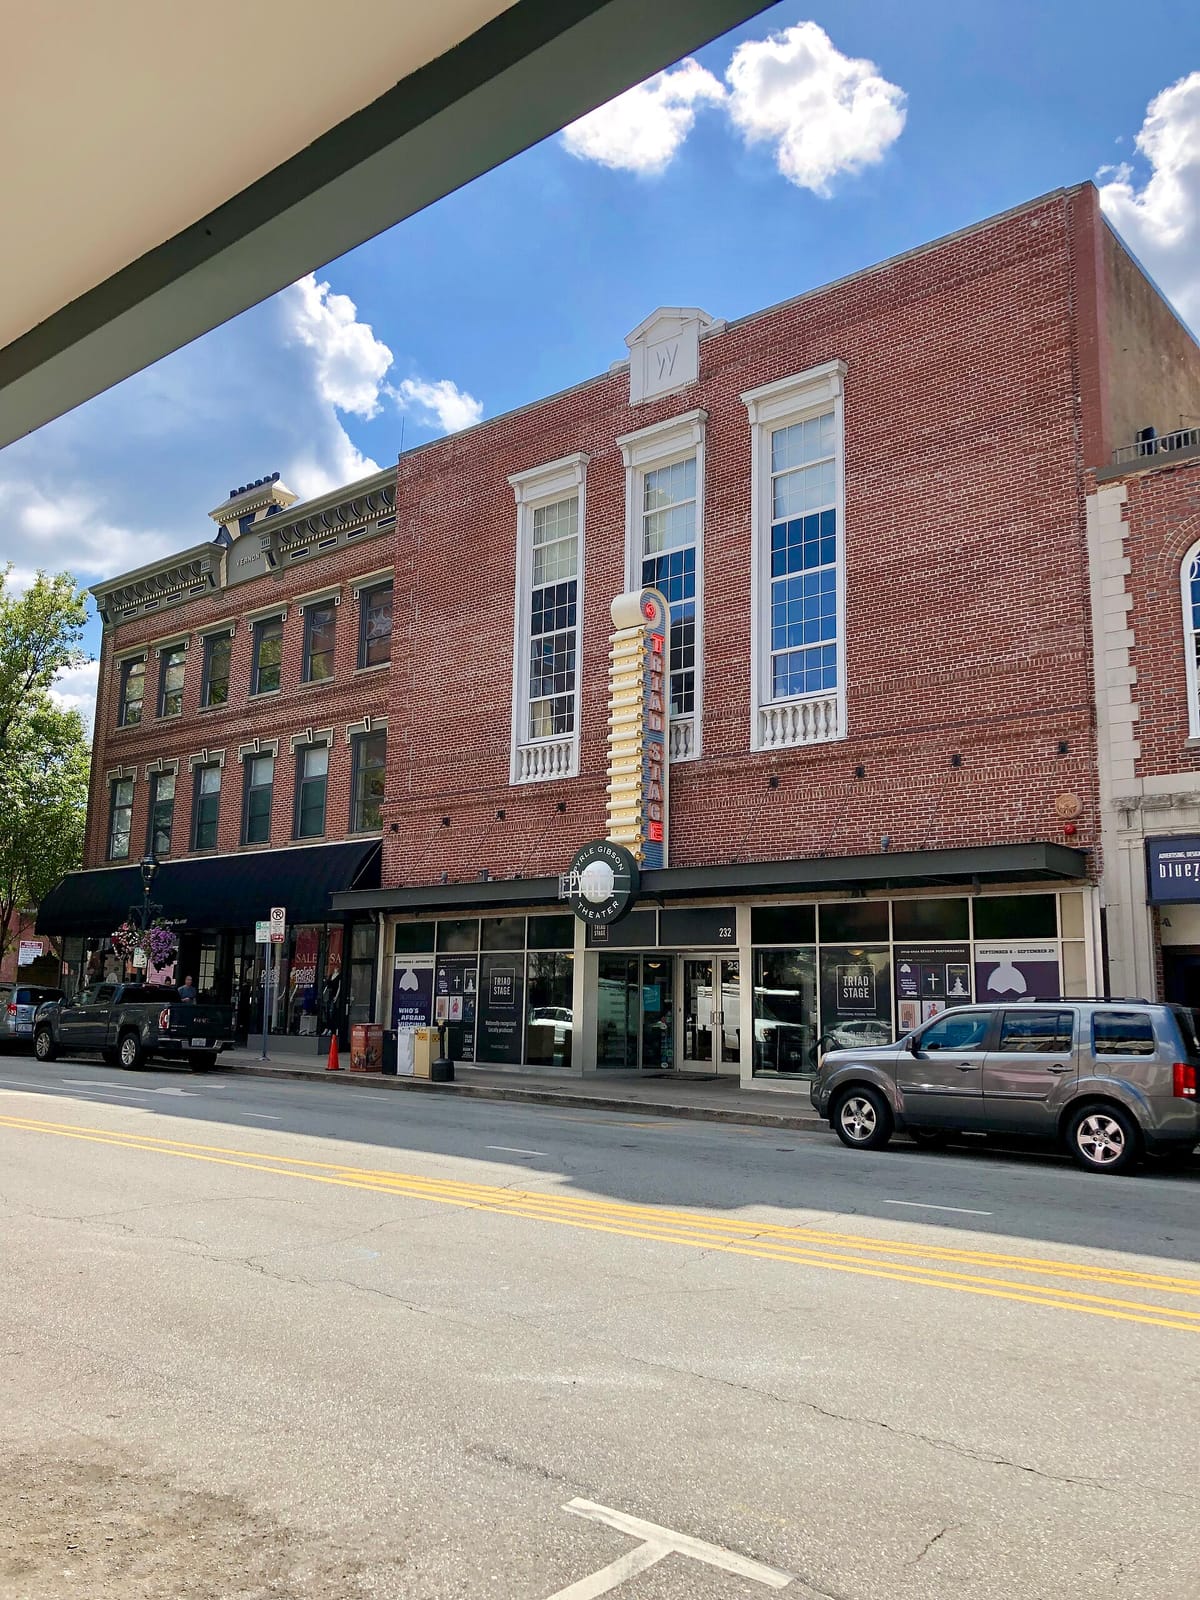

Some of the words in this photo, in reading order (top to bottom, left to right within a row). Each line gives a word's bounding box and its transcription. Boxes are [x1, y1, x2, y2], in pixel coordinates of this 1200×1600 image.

[656, 343, 679, 380] W
[236, 552, 261, 567] VERNON
[649, 632, 665, 732] TRIAD
[647, 742, 664, 842] STAGE
[573, 847, 595, 873] PYRLE
[597, 845, 625, 871] GIBSON
[577, 900, 620, 919] THEATER
[719, 927, 732, 938] 232
[296, 953, 317, 963] SALE
[494, 977, 511, 985] TRIAD
[843, 976, 869, 986] TRIAD
[493, 986, 511, 995] STAGE
[843, 987, 869, 998] STAGE
